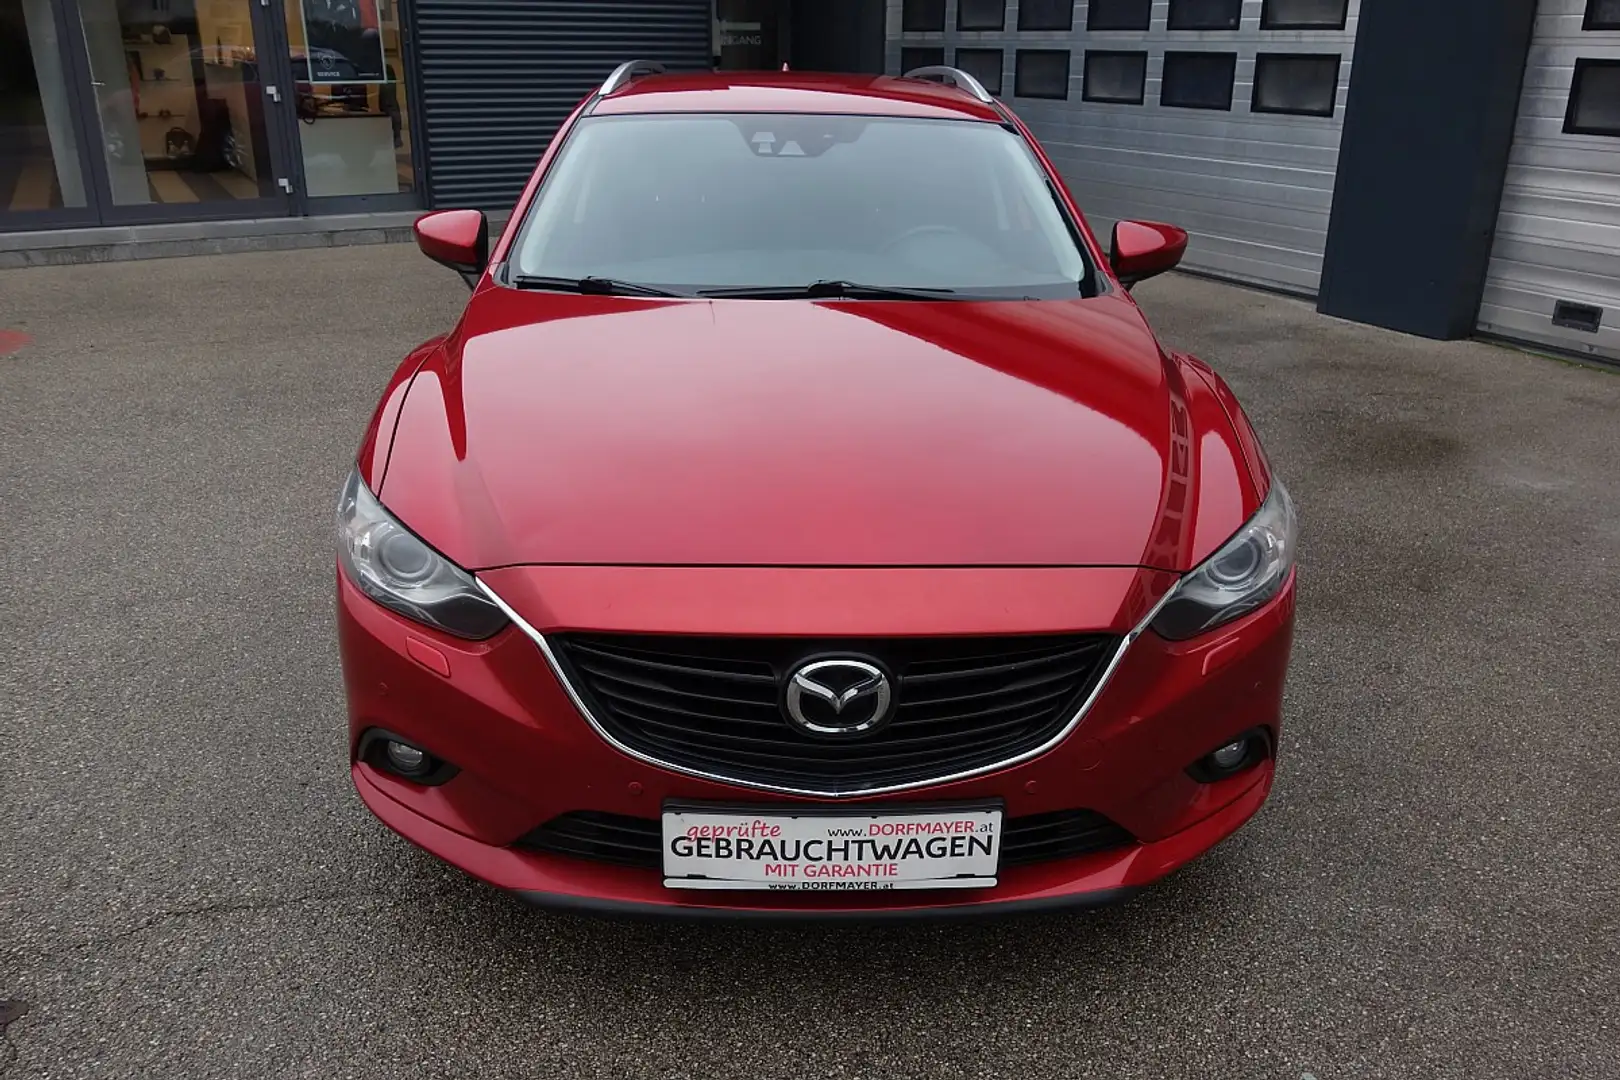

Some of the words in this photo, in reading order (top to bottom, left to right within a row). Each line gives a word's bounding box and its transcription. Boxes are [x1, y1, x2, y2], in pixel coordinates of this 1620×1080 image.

[687, 819, 781, 843] geprüfte
[827, 820, 994, 837] www.DORFMAYER.at
[671, 834, 993, 862] GEBRAUCHTWAGEN
[765, 863, 799, 877] MIT
[803, 863, 898, 878] GARANTIE
[768, 881, 894, 890] www.DORFMAYER.at
